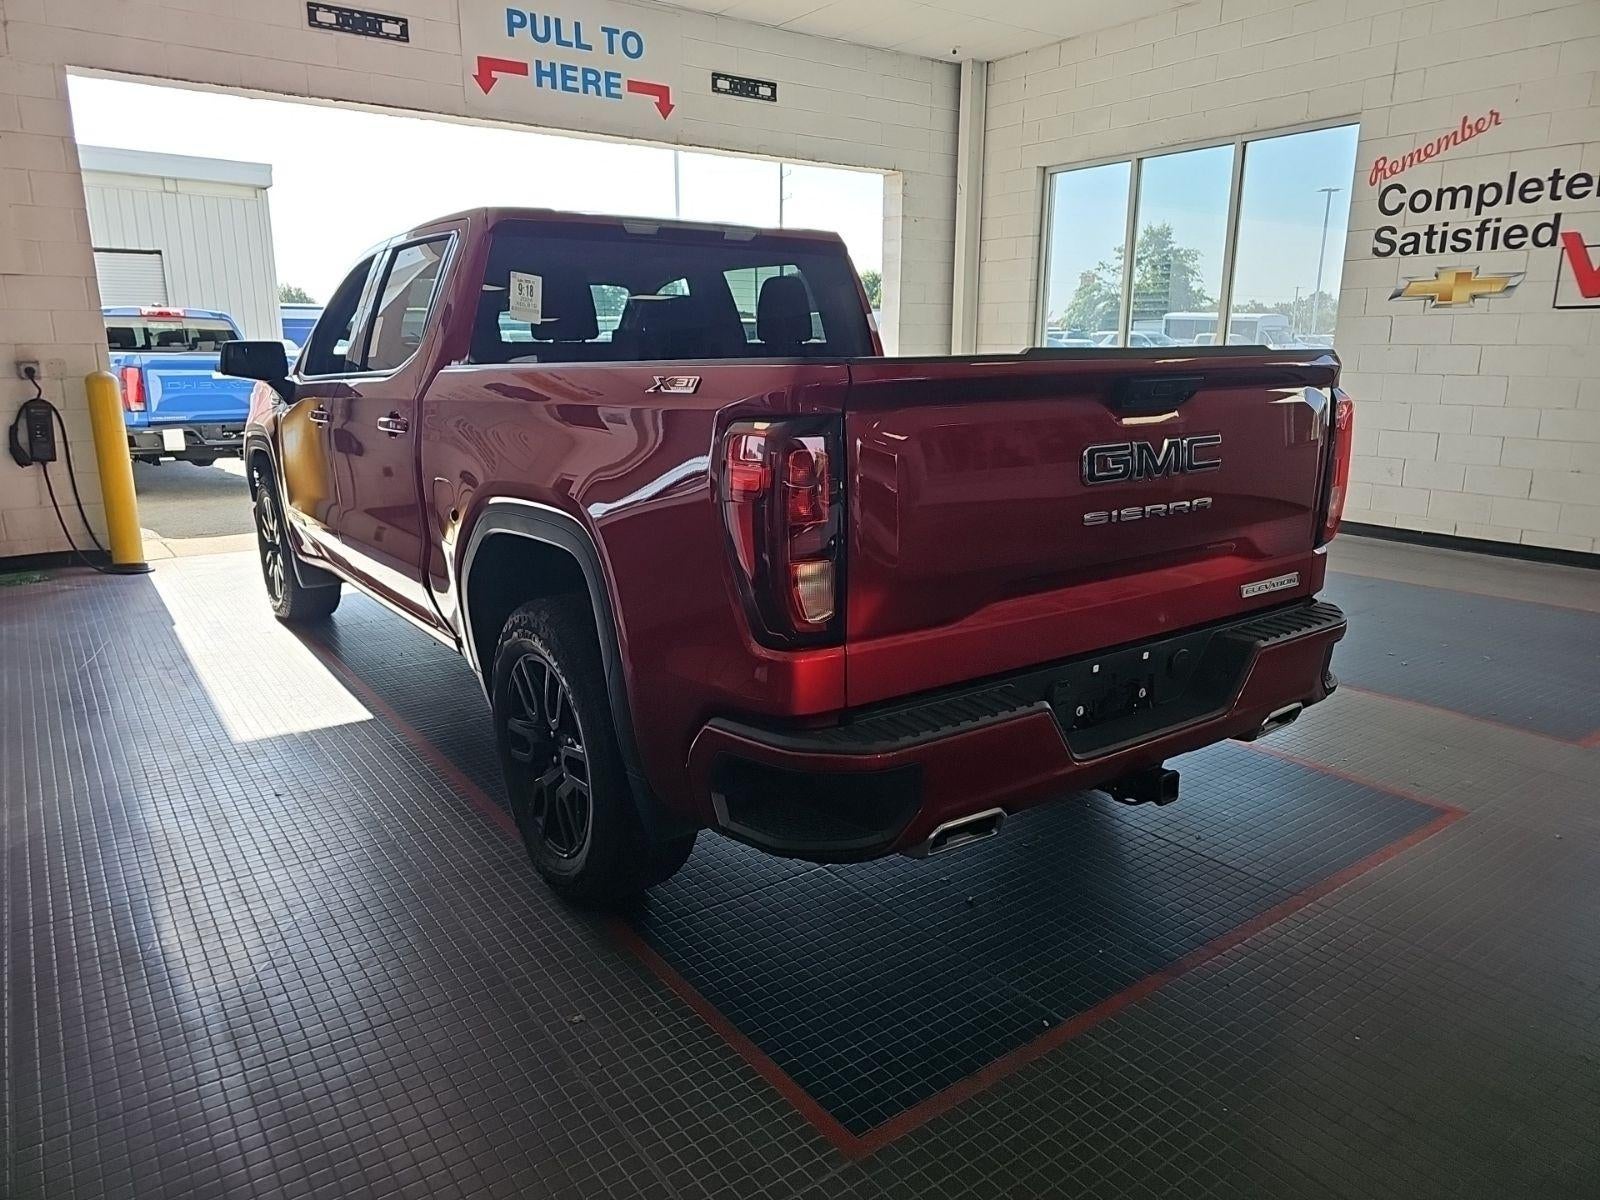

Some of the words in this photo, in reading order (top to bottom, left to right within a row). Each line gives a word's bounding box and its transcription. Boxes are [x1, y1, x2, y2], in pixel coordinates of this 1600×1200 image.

[506, 7, 593, 51] PULL
[600, 26, 644, 60] TO
[535, 59, 623, 100] HERE
[1369, 109, 1502, 187] Remember
[1372, 212, 1562, 258] Satisfied
[517, 283, 534, 298] 9:18
[1081, 433, 1222, 486] GMC
[1083, 497, 1213, 526] SIERRA
[1245, 577, 1297, 595] ELEVATION
